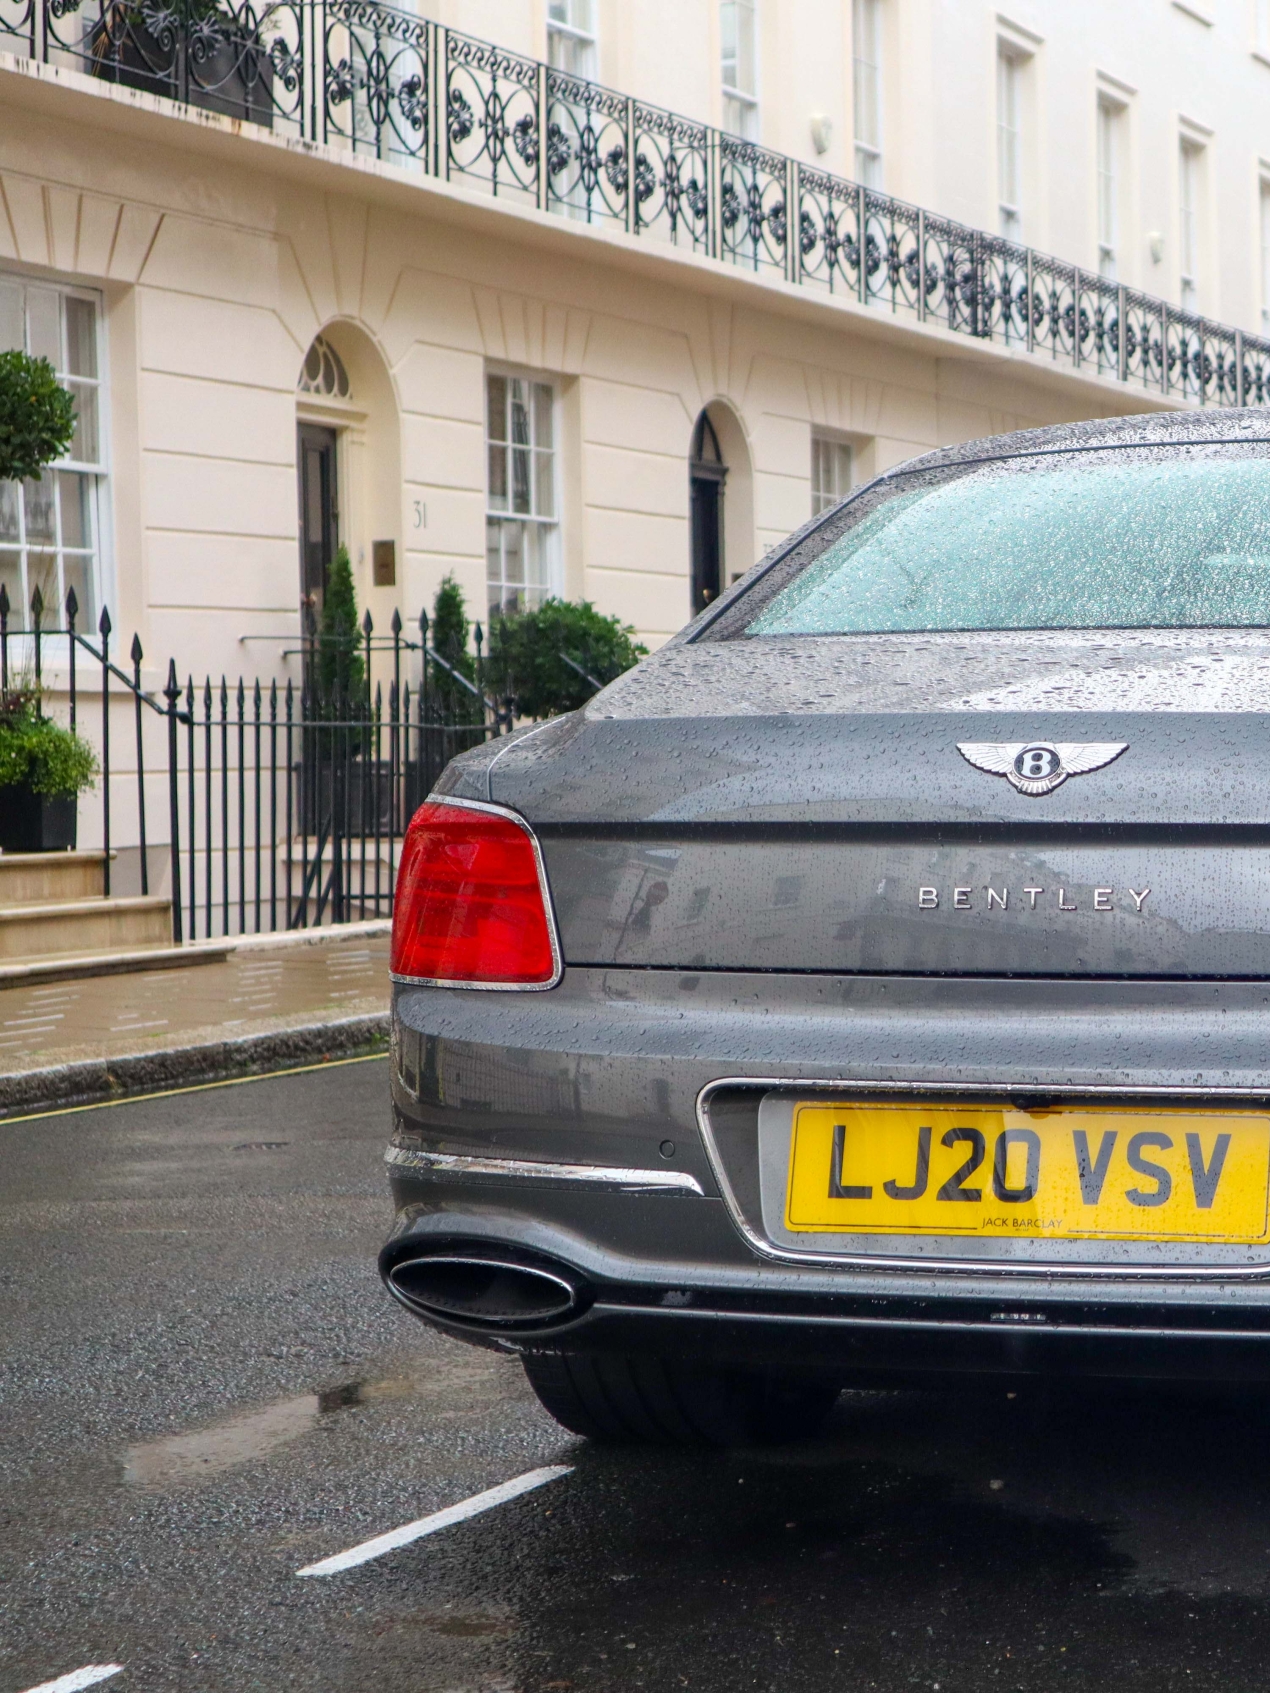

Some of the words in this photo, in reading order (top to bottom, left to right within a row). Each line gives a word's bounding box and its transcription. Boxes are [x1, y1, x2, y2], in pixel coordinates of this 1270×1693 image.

[413, 500, 427, 529] 31
[918, 887, 1152, 911] BENTLEY
[827, 1124, 1042, 1204] LJ20
[1072, 1129, 1233, 1209] VSV
[982, 1218, 1009, 1229] JACK
[1013, 1219, 1062, 1229] BARCLAY
